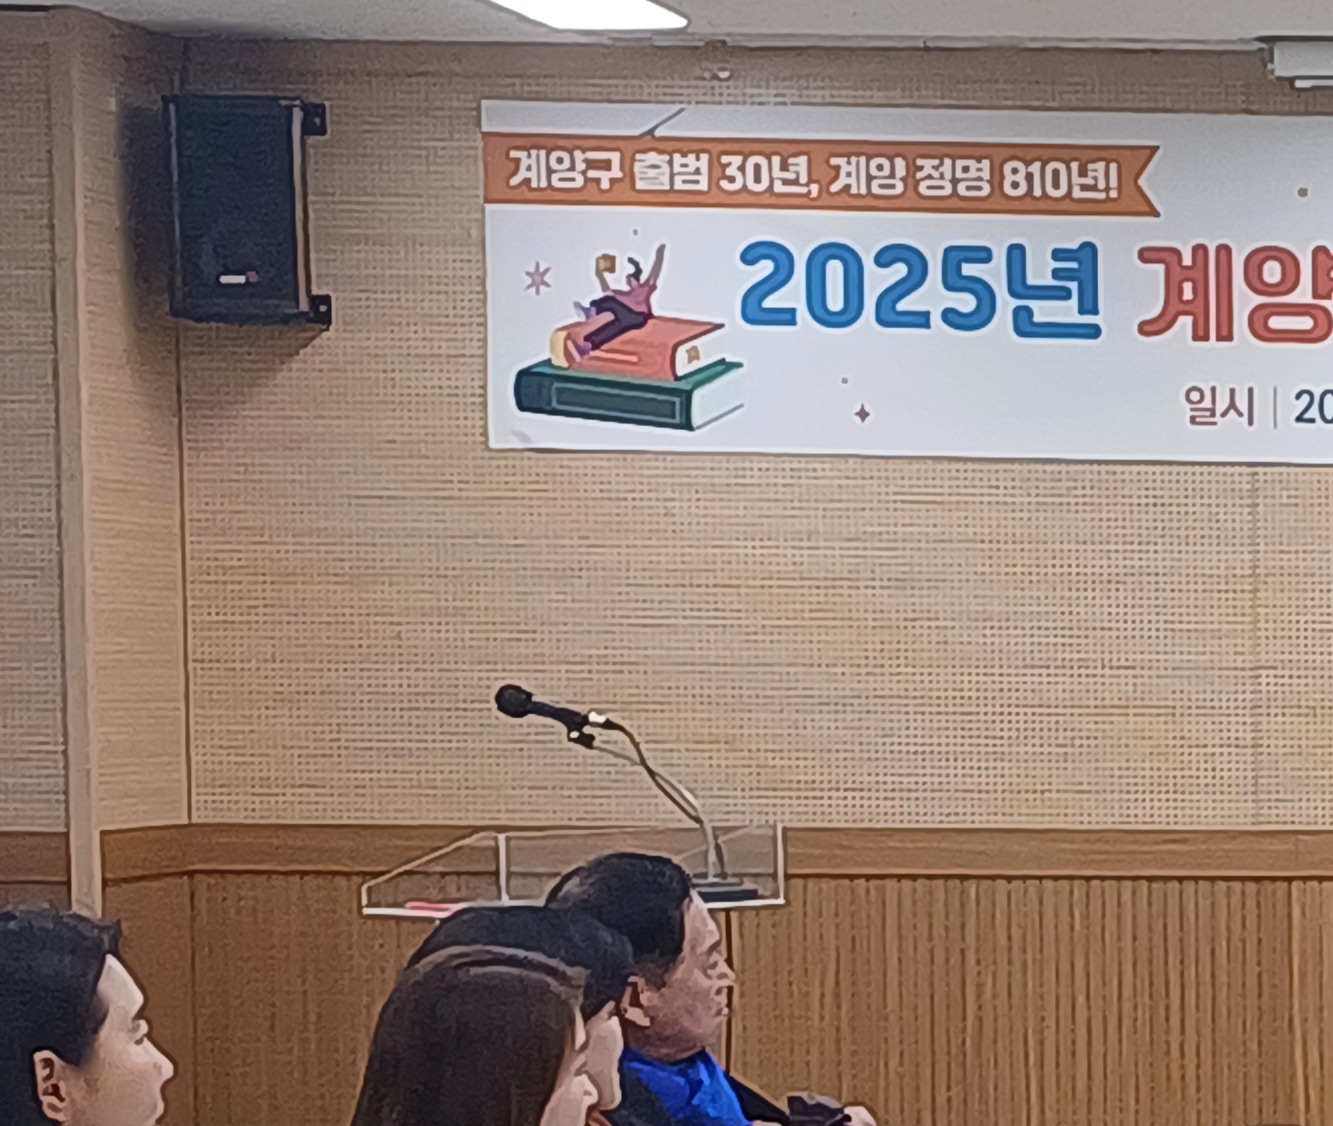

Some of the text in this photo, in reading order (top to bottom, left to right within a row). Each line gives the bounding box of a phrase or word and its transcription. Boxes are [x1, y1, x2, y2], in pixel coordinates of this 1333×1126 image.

[508, 148, 624, 190] 계양구
[634, 151, 710, 191] 출범
[718, 154, 819, 198] 30년,
[915, 157, 991, 197] 정명
[1002, 159, 1118, 199] 810년!
[739, 240, 1102, 340] 2025년
[1184, 385, 1257, 428] 일시
